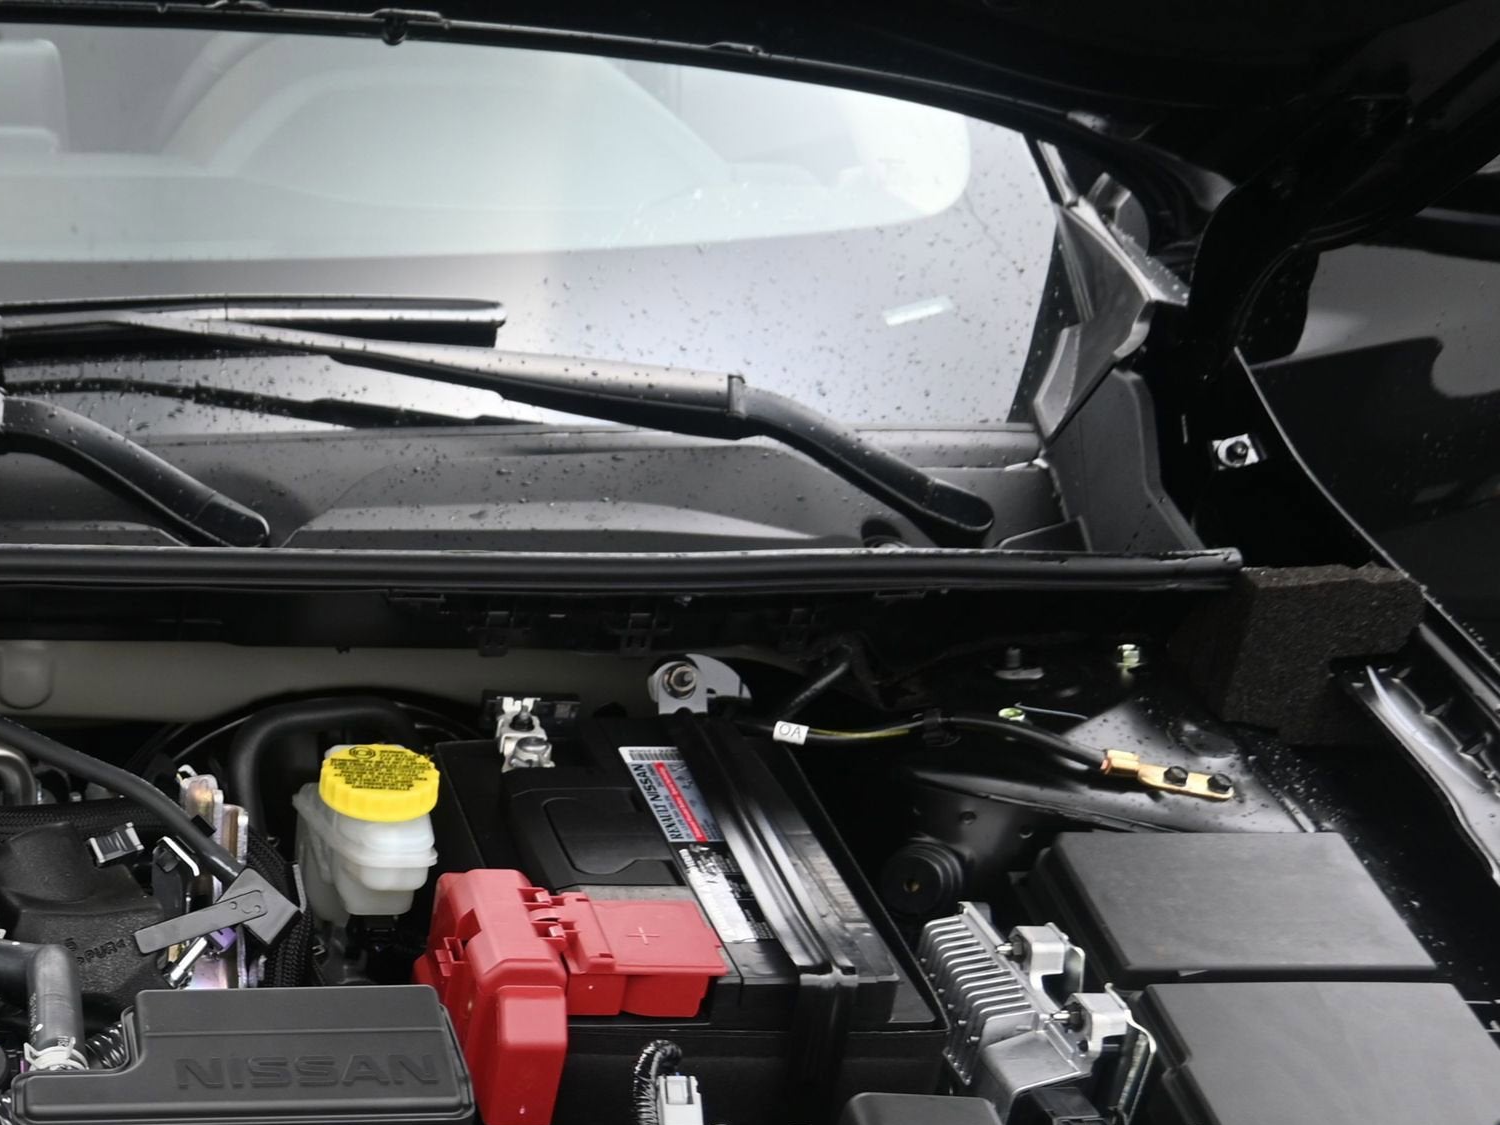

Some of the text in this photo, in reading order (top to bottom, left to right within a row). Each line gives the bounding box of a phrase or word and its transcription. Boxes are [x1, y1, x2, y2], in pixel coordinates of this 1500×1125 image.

[631, 763, 664, 802] NISSAN
[652, 803, 684, 839] RENAULT
[173, 1053, 440, 1090] NISSAN
